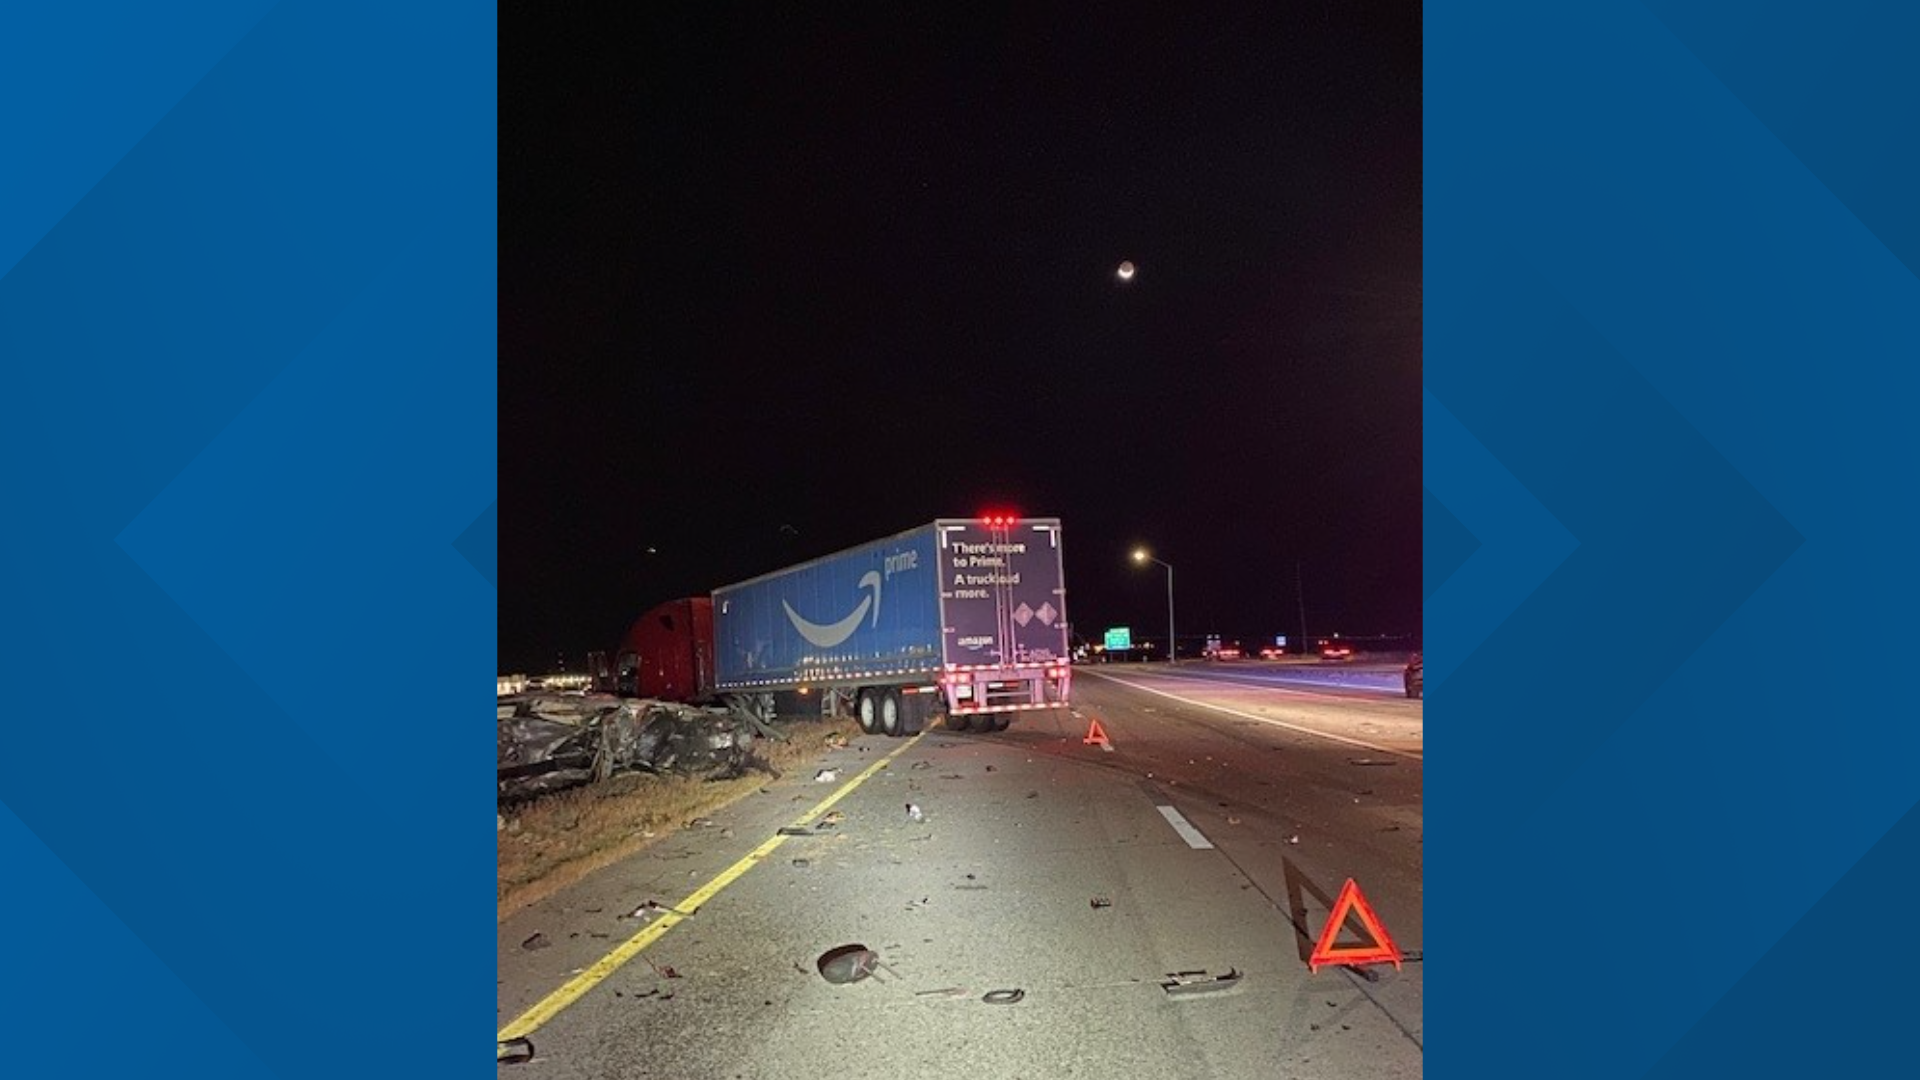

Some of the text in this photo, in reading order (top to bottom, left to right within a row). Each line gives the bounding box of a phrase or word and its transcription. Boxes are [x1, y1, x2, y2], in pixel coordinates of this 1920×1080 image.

[952, 541, 994, 553] There's
[885, 548, 918, 581] prime
[953, 556, 1005, 567] to Prime.
[954, 572, 1020, 585] A truckoad
[955, 589, 990, 598] more.
[957, 636, 994, 646] amazon
